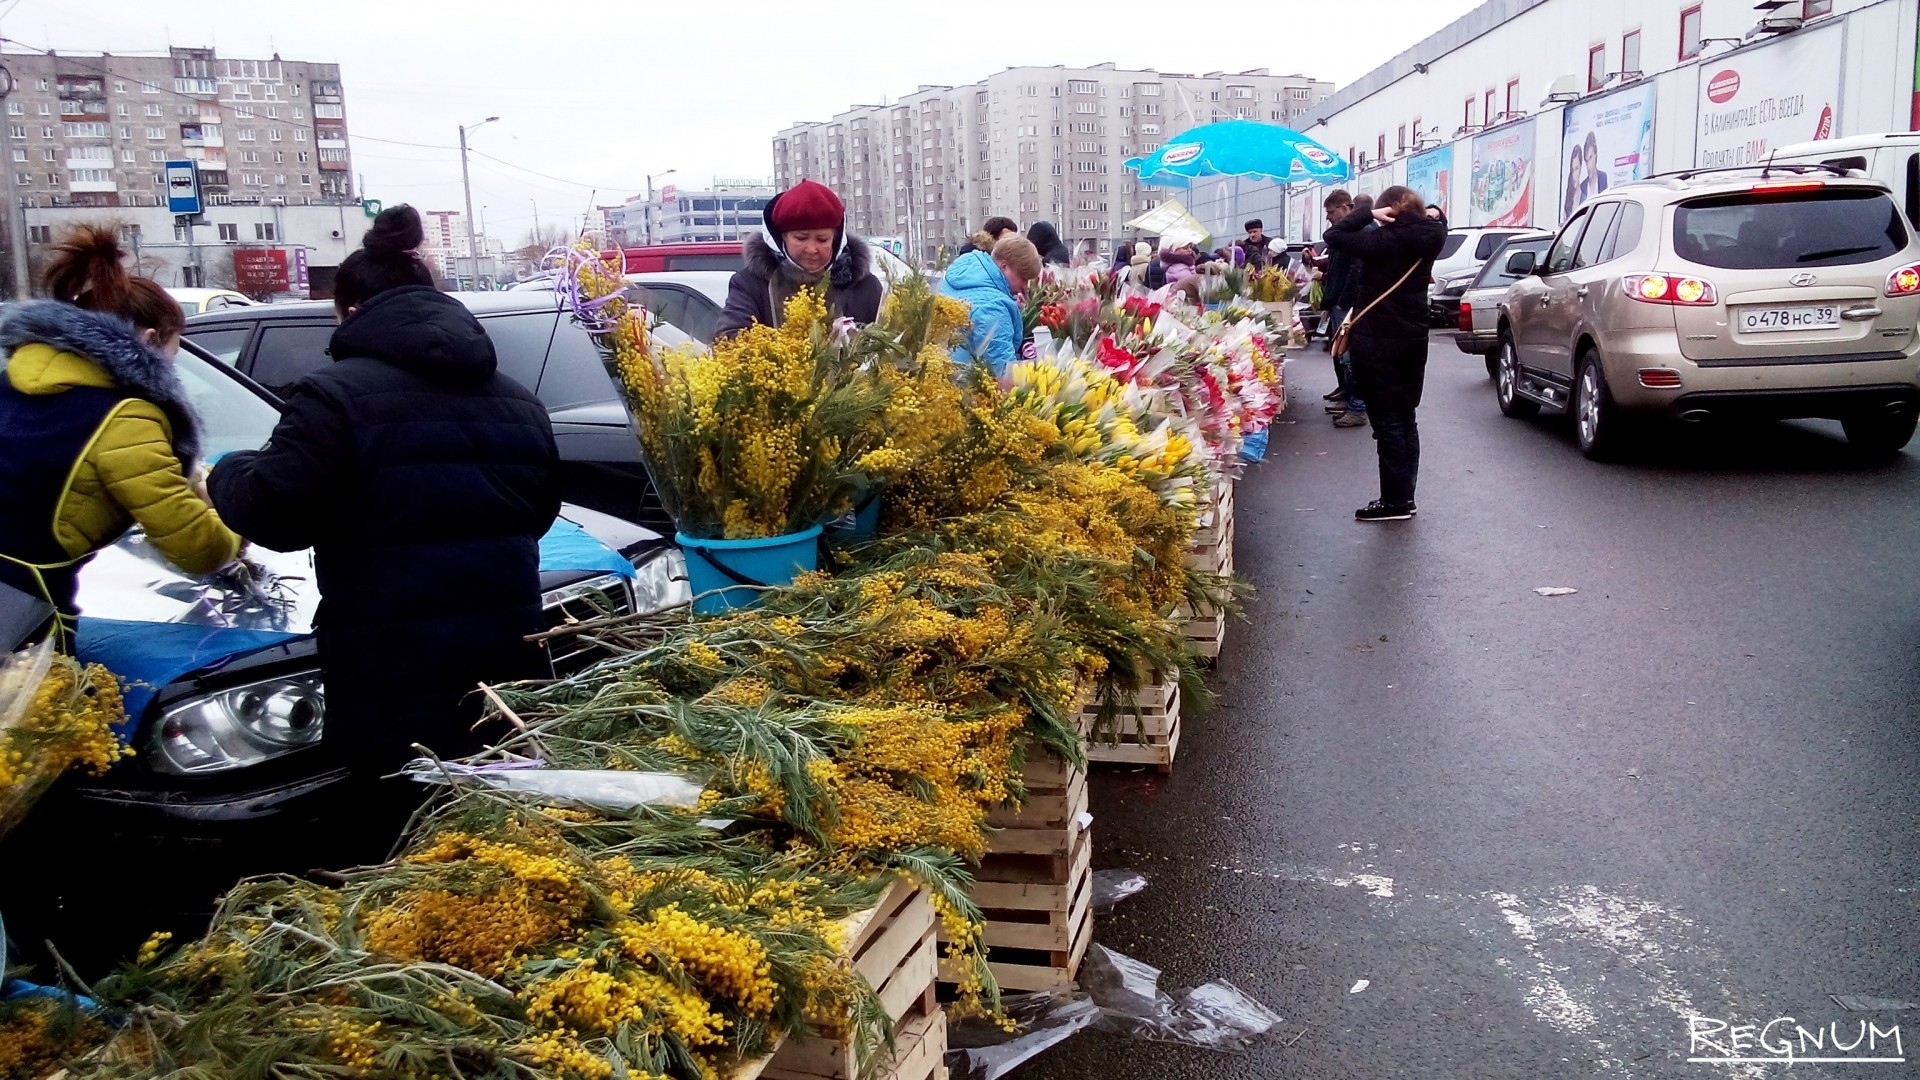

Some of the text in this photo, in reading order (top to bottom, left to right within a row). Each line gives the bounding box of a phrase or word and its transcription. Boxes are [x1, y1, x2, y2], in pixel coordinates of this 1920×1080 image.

[1704, 113, 1709, 136] В
[1760, 97, 1777, 124] ЕСТЬ
[1779, 94, 1804, 120] ВСЕГДА
[1736, 146, 1744, 166] ОТ
[299, 251, 308, 280] ВХОД
[1817, 308, 1832, 320] 39
